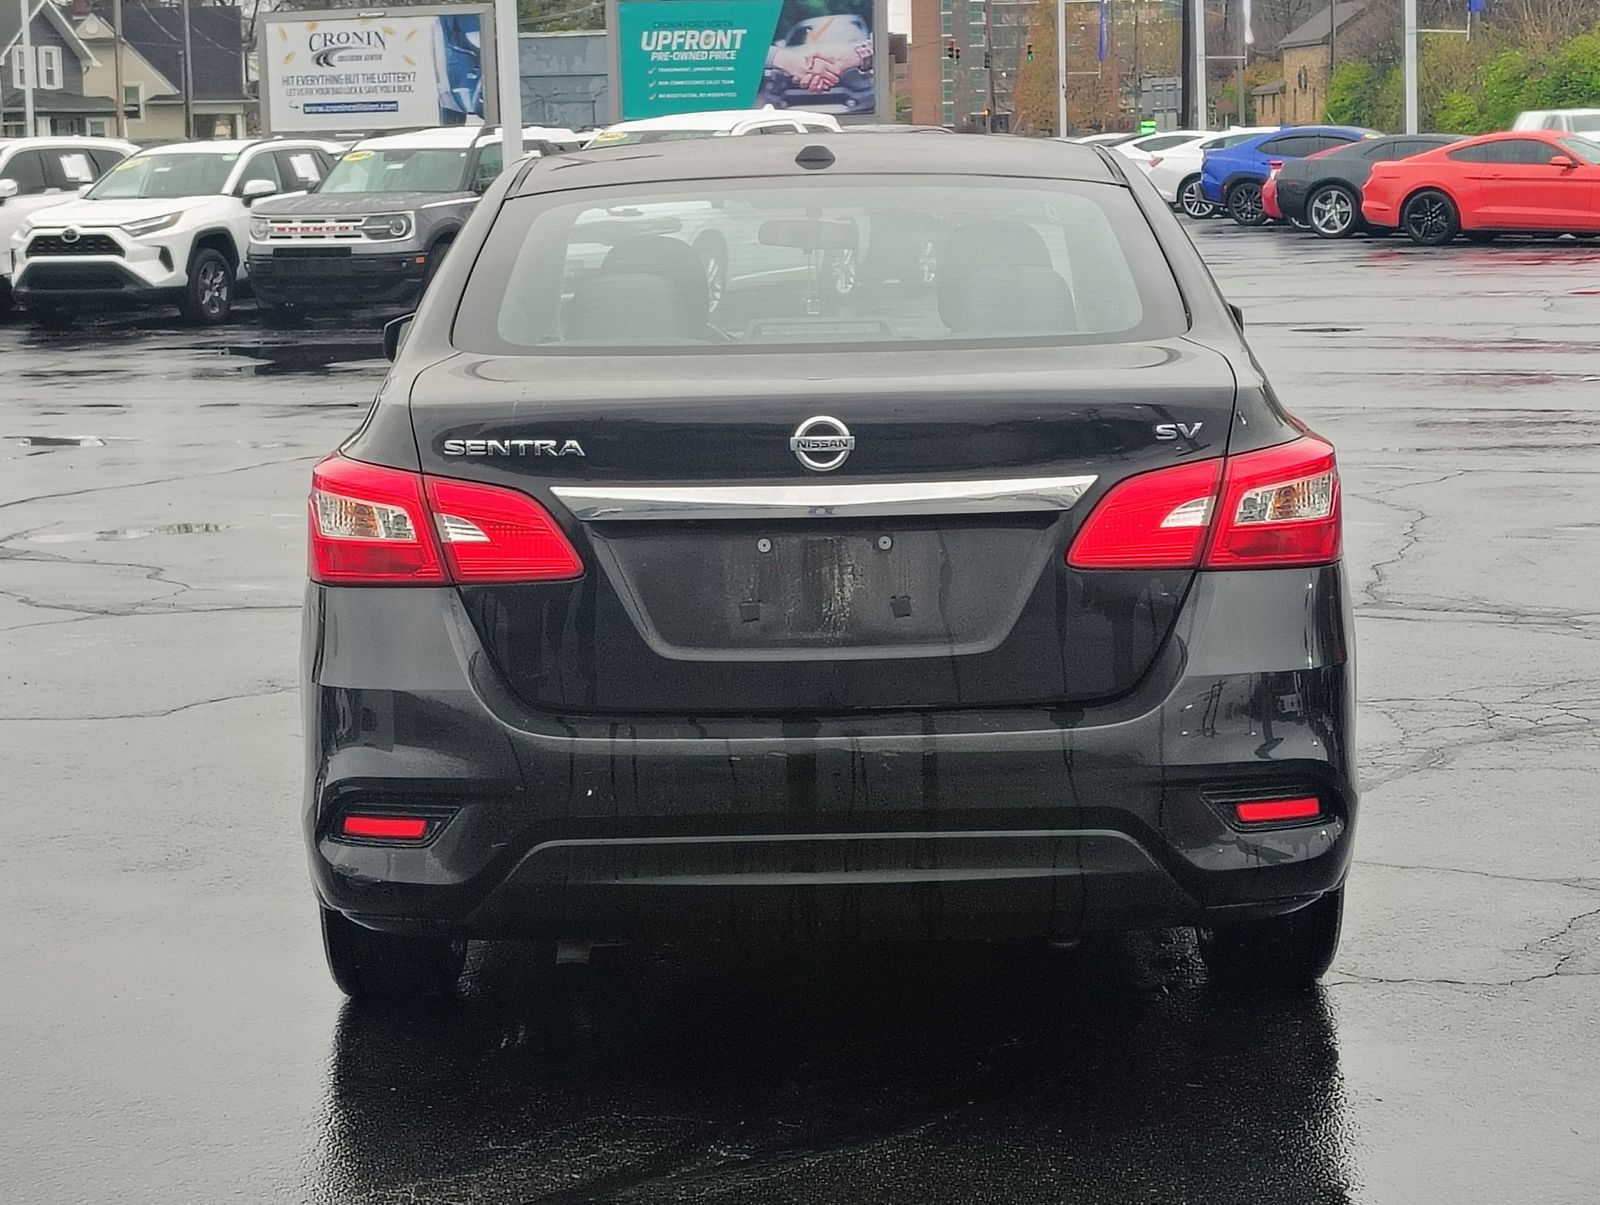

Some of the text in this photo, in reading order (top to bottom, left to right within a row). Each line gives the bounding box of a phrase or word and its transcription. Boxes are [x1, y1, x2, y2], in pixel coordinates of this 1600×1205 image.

[309, 31, 386, 52] CRONIN
[641, 29, 747, 50] UPFRONT
[650, 50, 737, 61] PRE-OWNED PRICE
[282, 71, 416, 86] HIT EVERYTHING BUT THE LOTTERY?
[1155, 422, 1203, 440] SV
[443, 439, 586, 457] SENTRA
[796, 439, 848, 449] NISSAN
